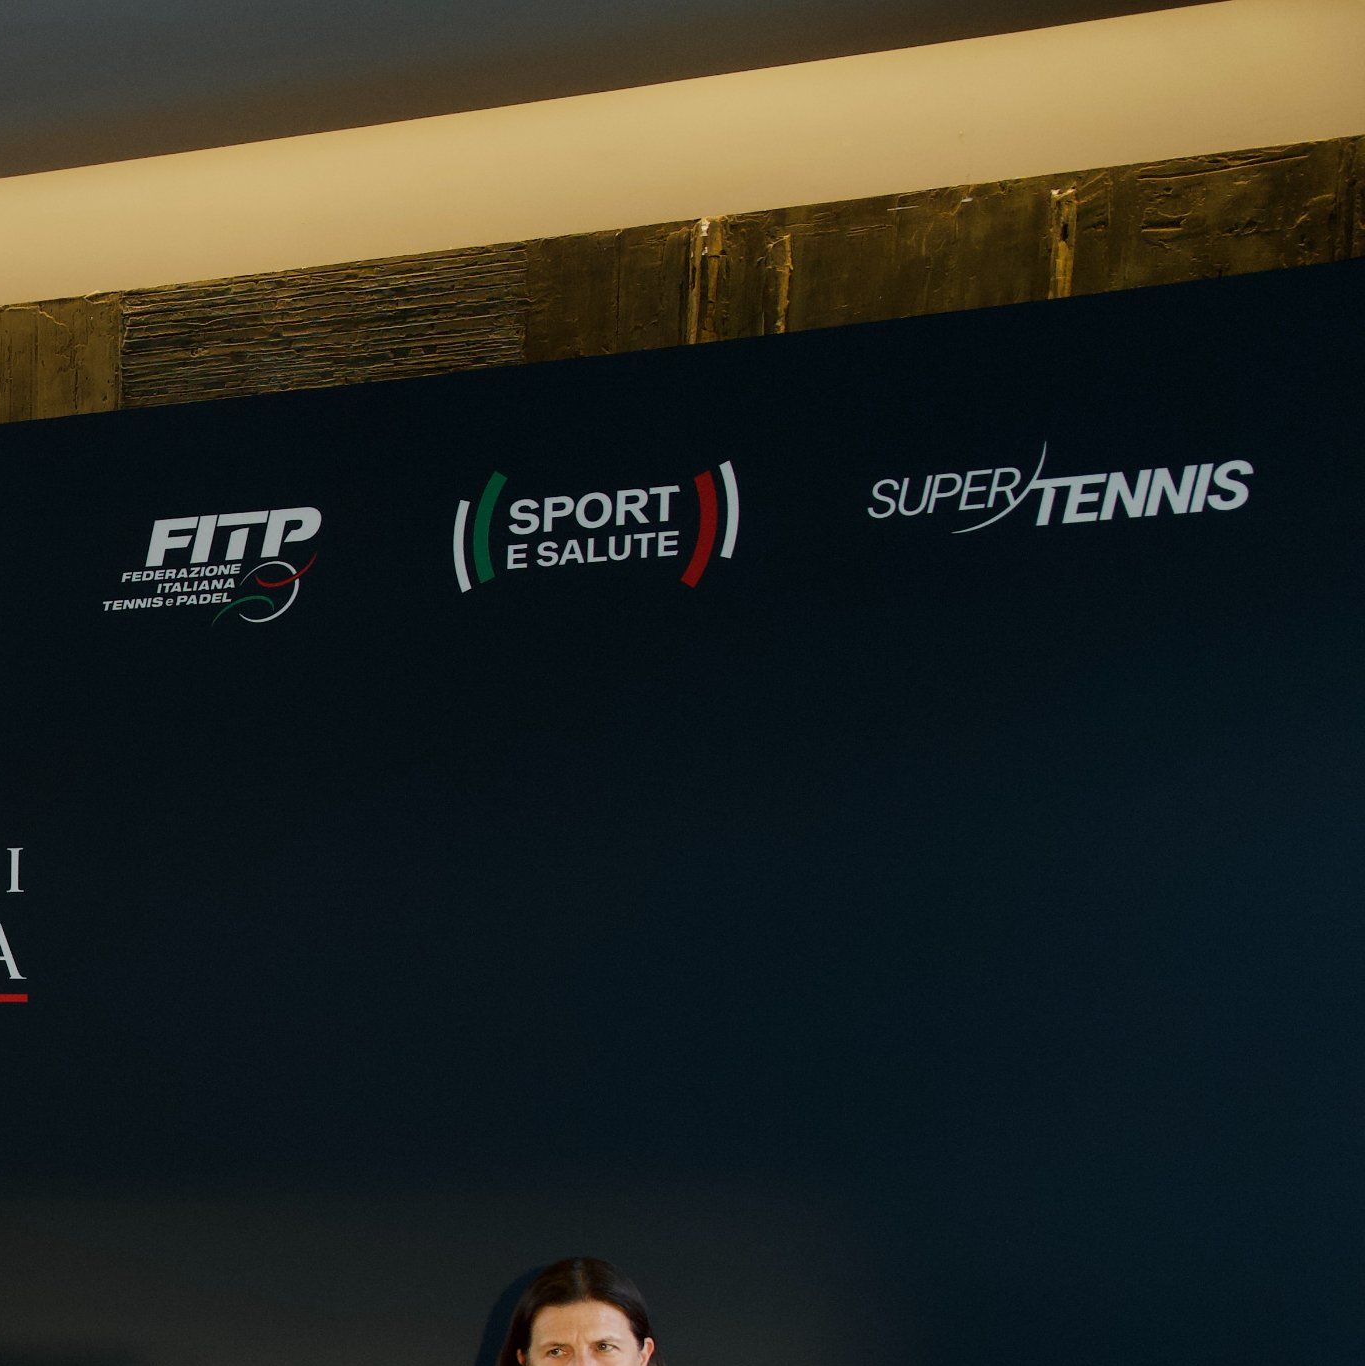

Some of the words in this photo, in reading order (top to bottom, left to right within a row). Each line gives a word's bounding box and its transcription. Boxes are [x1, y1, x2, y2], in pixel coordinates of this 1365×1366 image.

[508, 485, 680, 535] SPORT
[868, 467, 1022, 519] SUPER
[1030, 459, 1254, 527] TENNIS
[145, 506, 322, 567] FITP
[507, 544, 528, 570] E
[536, 530, 680, 567] SALUTE
[121, 564, 242, 582] FEDERAZIONE
[156, 578, 236, 594] ITALIANA
[102, 597, 164, 611] TENNIS
[165, 598, 174, 607] e
[175, 592, 232, 606] PADEL
